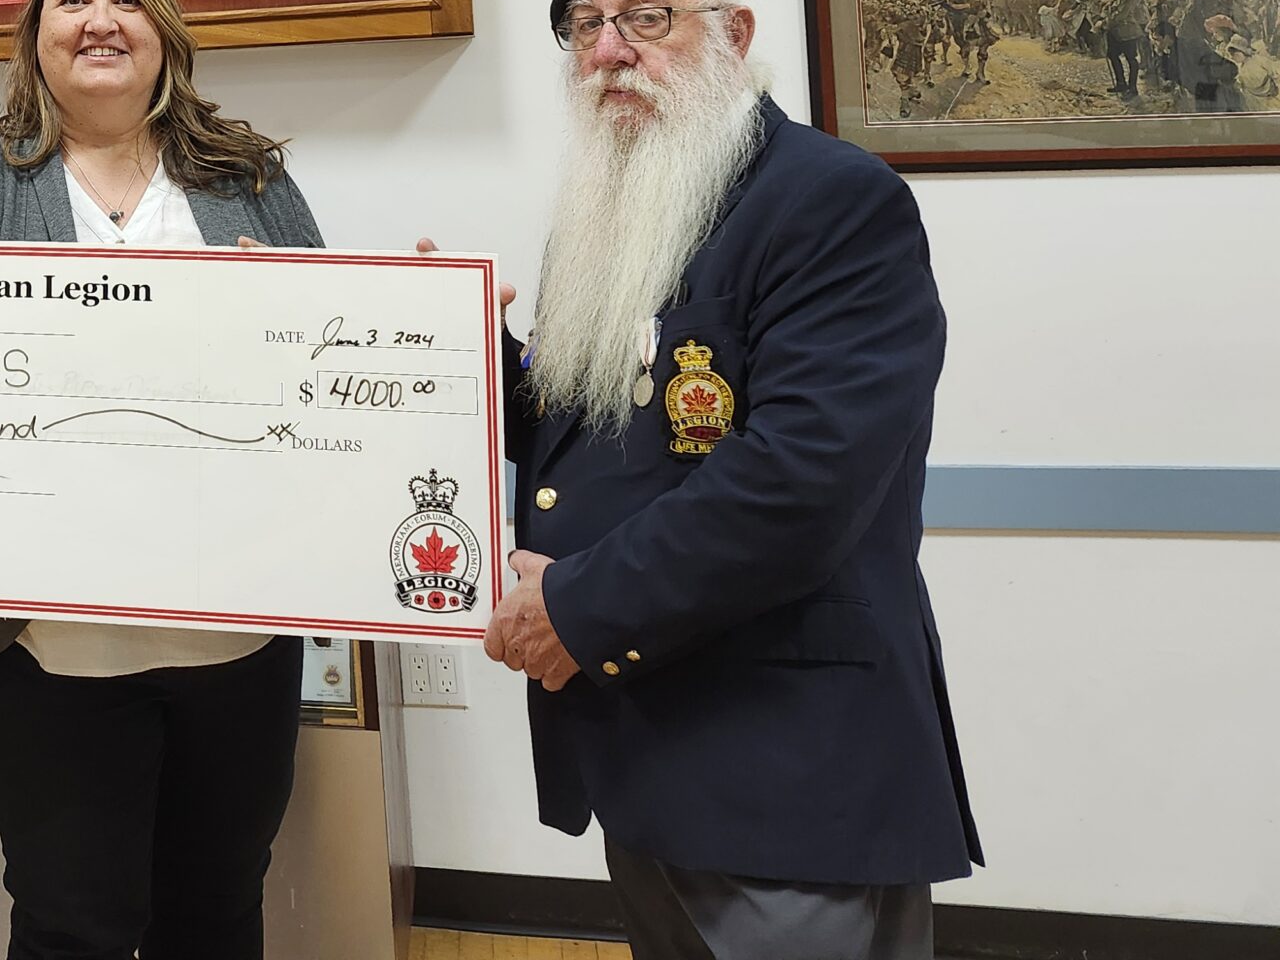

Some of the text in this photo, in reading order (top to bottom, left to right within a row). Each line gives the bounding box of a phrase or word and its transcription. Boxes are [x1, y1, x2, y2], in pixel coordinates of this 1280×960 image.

[43, 274, 153, 307] Legion
[265, 330, 305, 343] DATE
[366, 329, 378, 346] 3
[393, 331, 435, 349] 2024
[299, 379, 314, 407] $
[677, 416, 726, 429] LEGION
[292, 437, 363, 452] DOLLARS
[393, 513, 478, 580] MEMORIAM EORUM RETINEBIMUS
[402, 577, 471, 595] LEGION
